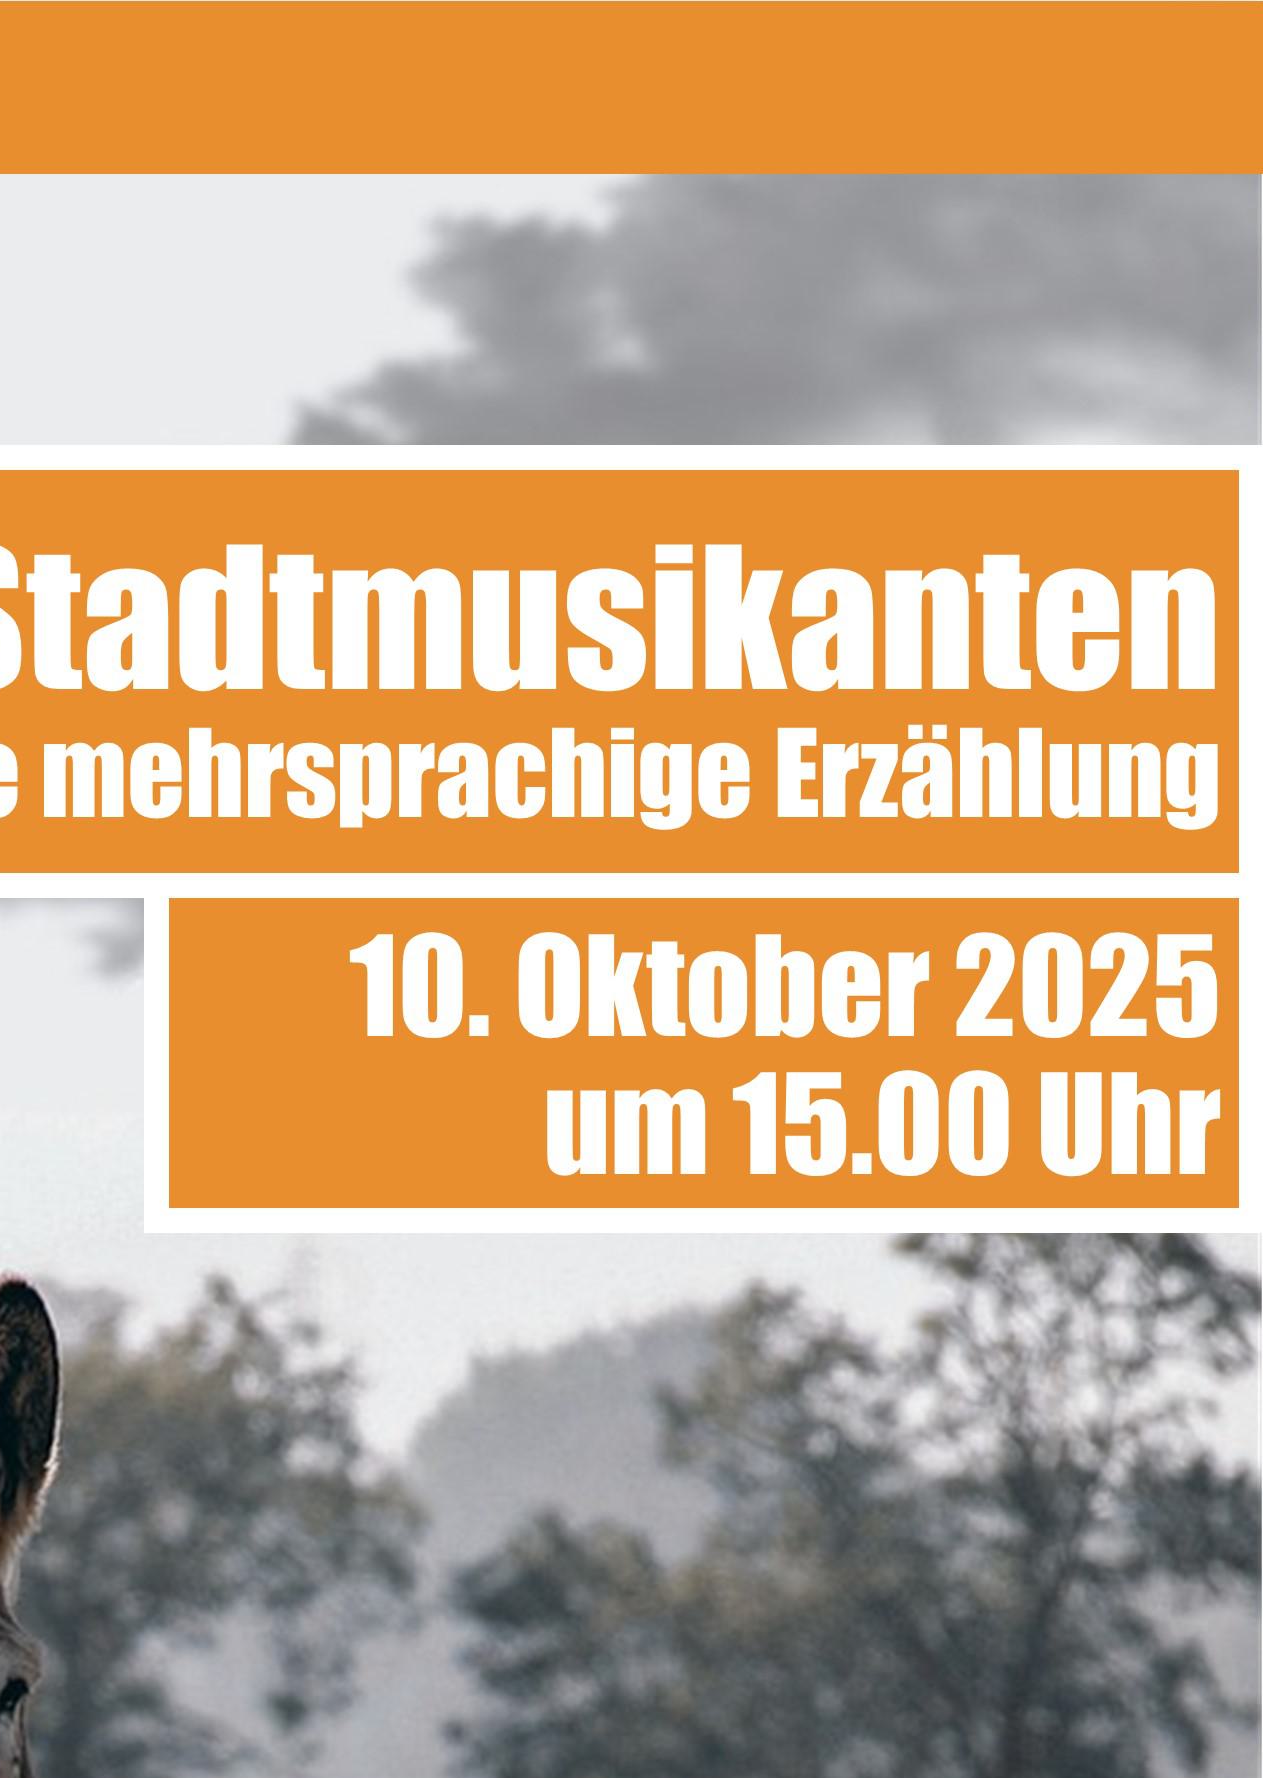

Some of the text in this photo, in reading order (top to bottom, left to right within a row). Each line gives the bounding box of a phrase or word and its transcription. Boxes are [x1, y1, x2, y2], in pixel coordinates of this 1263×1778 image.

[44, 728, 750, 830] mehrsprachige
[778, 725, 1218, 830] Erzählung
[350, 932, 1217, 1038] 10. Oktober 2025
[547, 1070, 1220, 1176] um 15.00 Uhr
